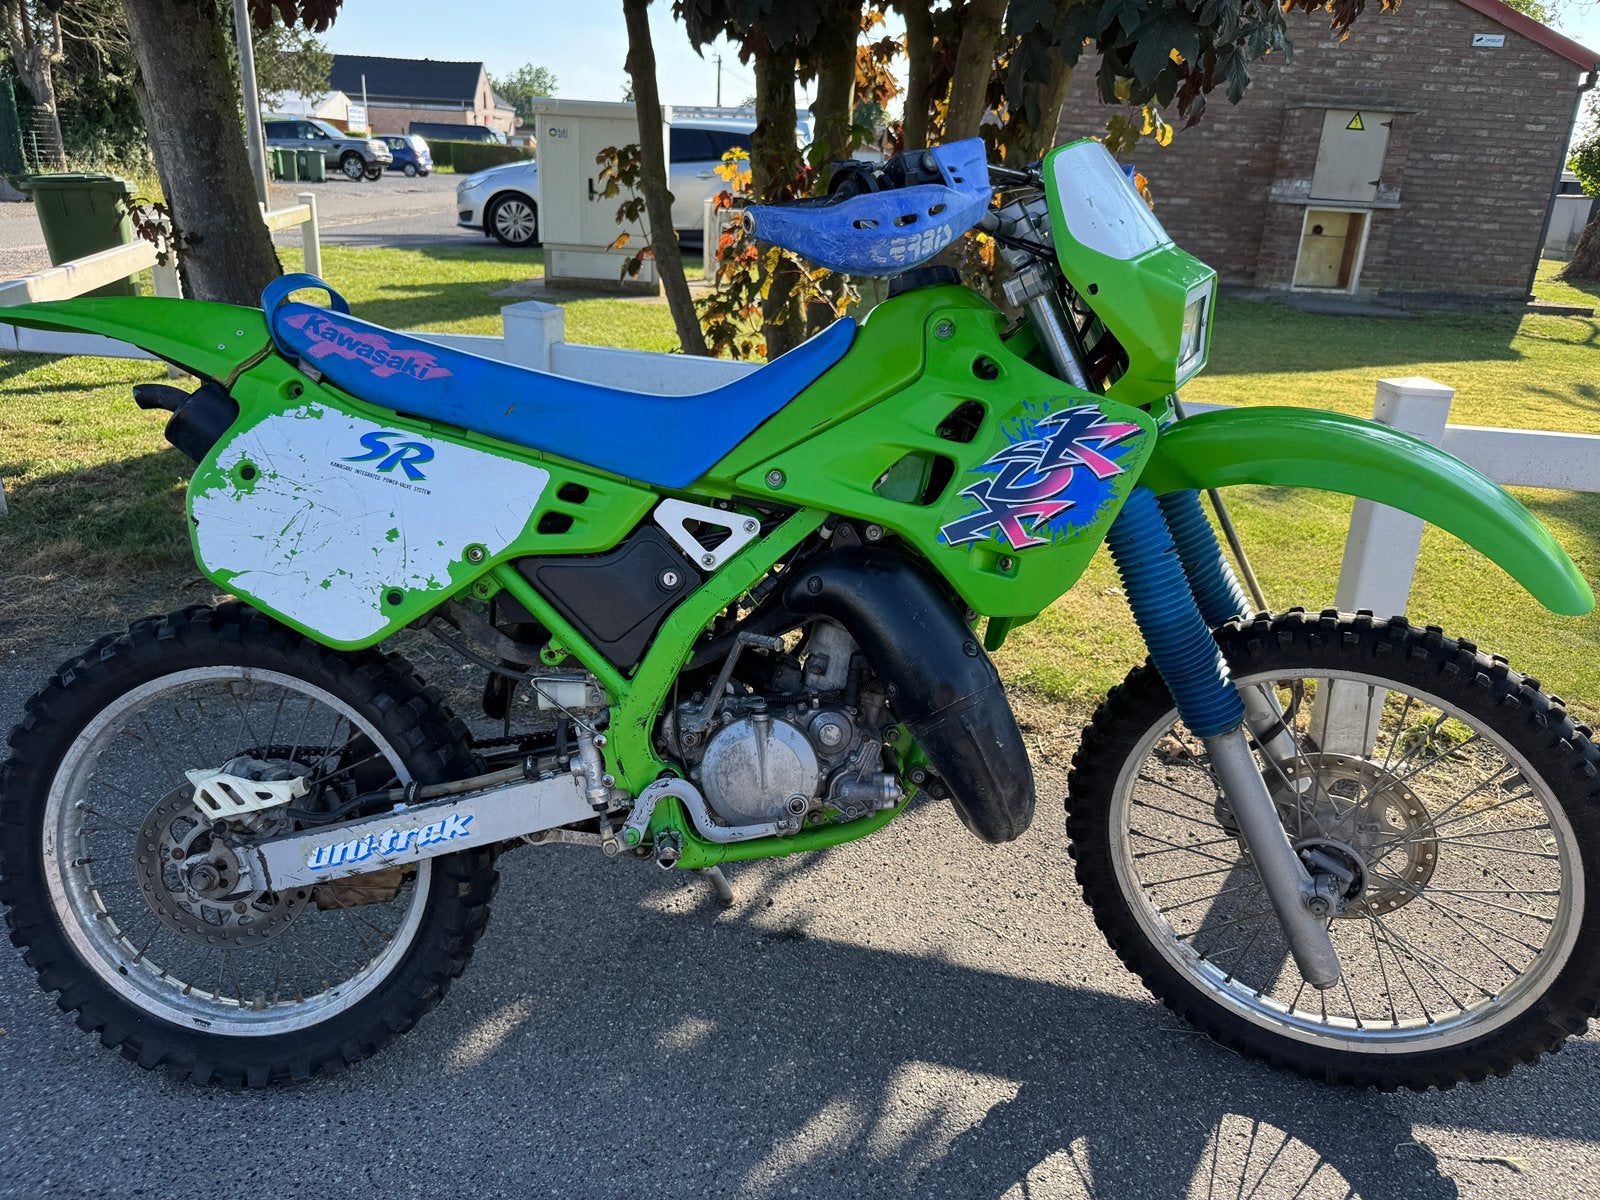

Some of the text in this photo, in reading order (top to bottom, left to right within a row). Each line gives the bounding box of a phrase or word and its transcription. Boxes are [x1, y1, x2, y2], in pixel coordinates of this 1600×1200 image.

[302, 314, 432, 380] Kawasaki
[329, 461, 432, 496] KAWASAKI INTEGRATED POWER-VALVE SYSTEM
[340, 431, 435, 481] SR
[306, 813, 474, 870] uni-trak
